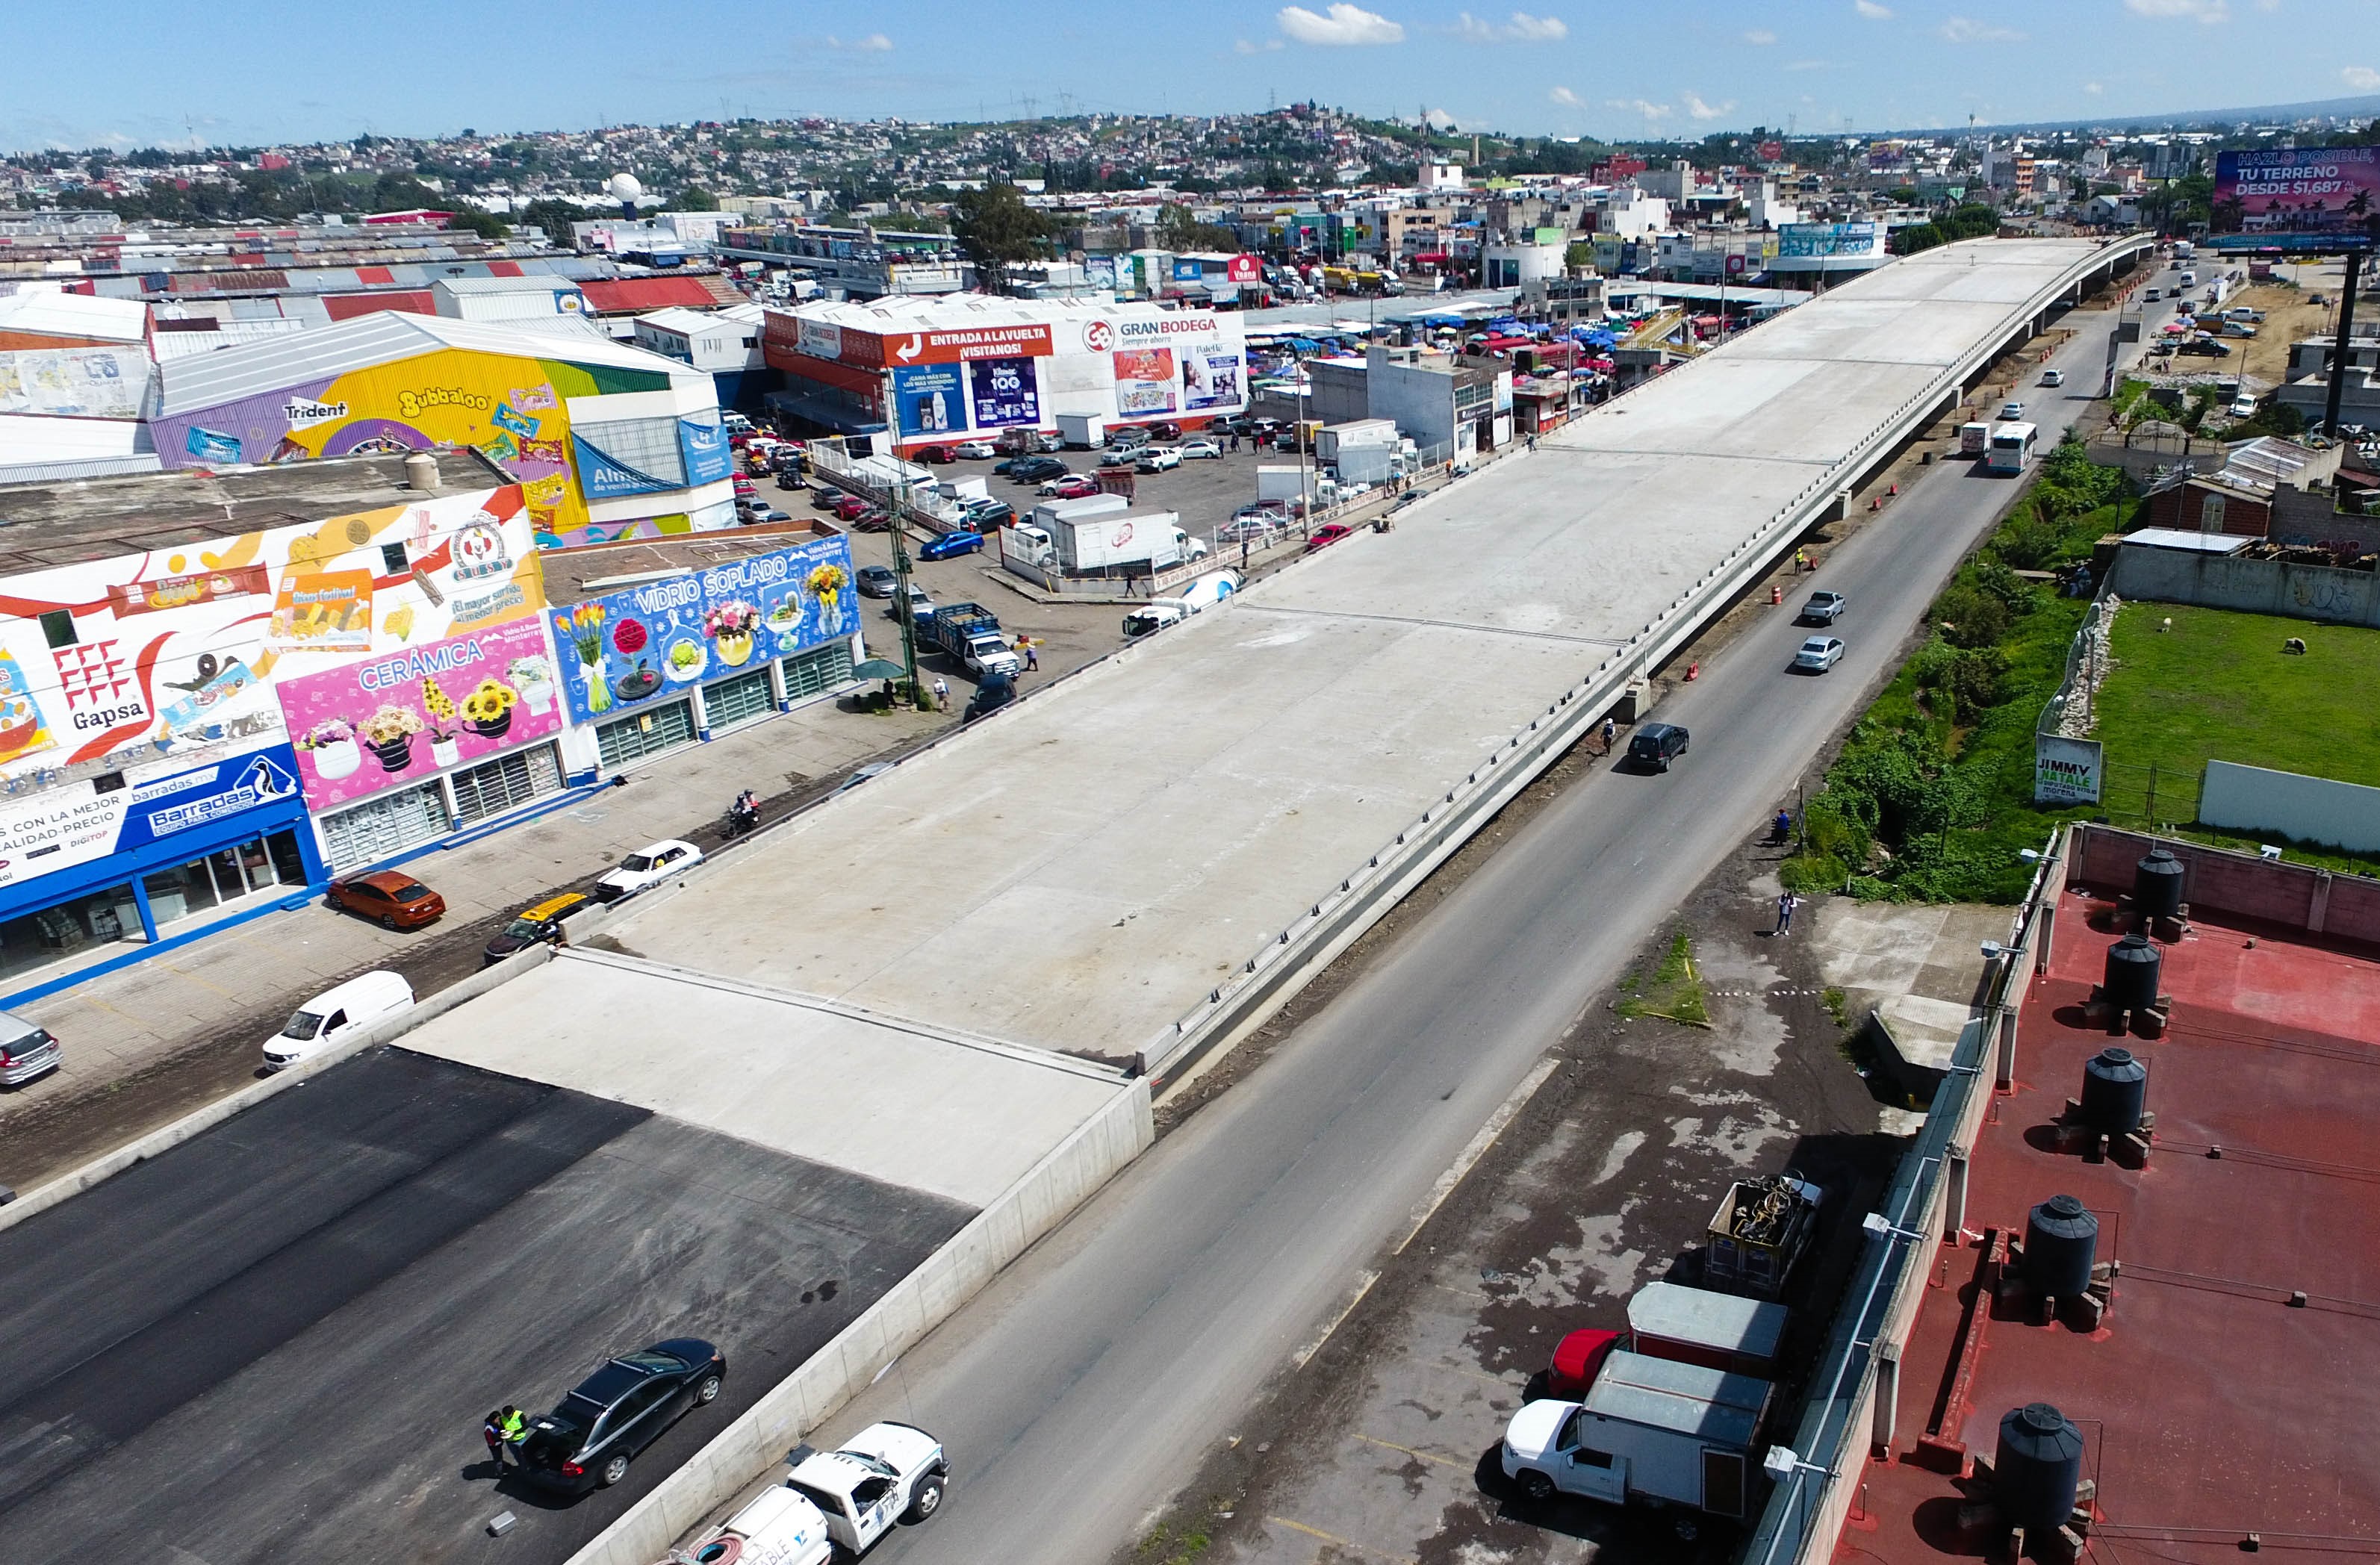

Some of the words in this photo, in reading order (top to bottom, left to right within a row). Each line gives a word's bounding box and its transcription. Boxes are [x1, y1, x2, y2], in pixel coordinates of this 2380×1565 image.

[2237, 152, 2295, 166] HAZLO
[2298, 149, 2375, 164] POSIBLE,
[2237, 168, 2258, 181] TU
[2262, 166, 2339, 180] TERRENO
[2236, 182, 2289, 196] DESDE
[1120, 321, 1159, 335] GRAN
[1160, 319, 1217, 333] BODEGA
[930, 332, 983, 346] ENTRADA
[984, 332, 992, 343] A
[992, 331, 1004, 342] LA
[1004, 328, 1046, 341] VUELTA
[1122, 337, 1149, 346] Siempre
[1150, 336, 1172, 344] ahorro
[990, 376, 1021, 390] 100
[285, 401, 347, 420] Trident
[399, 387, 489, 418] Bubbaloo
[606, 482, 630, 491] venta
[456, 560, 508, 580] SUSY
[637, 579, 701, 615] VIDRIO
[704, 556, 788, 597] SOPLADO
[464, 595, 491, 611] mayor
[493, 584, 521, 600] surtido
[465, 606, 494, 623] menor
[503, 629, 543, 644] Monterrey
[359, 639, 485, 691] CERÁMICA
[73, 703, 144, 730] Gapsa
[2039, 759, 2091, 777] JIMMY
[131, 773, 216, 803] barradas.mx
[2042, 770, 2092, 788] NATALE
[2043, 786, 2076, 797] morena
[13, 817, 46, 833] CON
[50, 811, 69, 823] LA
[73, 796, 120, 817] MEJOR
[152, 788, 253, 827] Barradas
[0, 812, 115, 853] ALIDAD-PRECIO
[155, 820, 187, 835] EQUIPO
[188, 814, 210, 825] PARA
